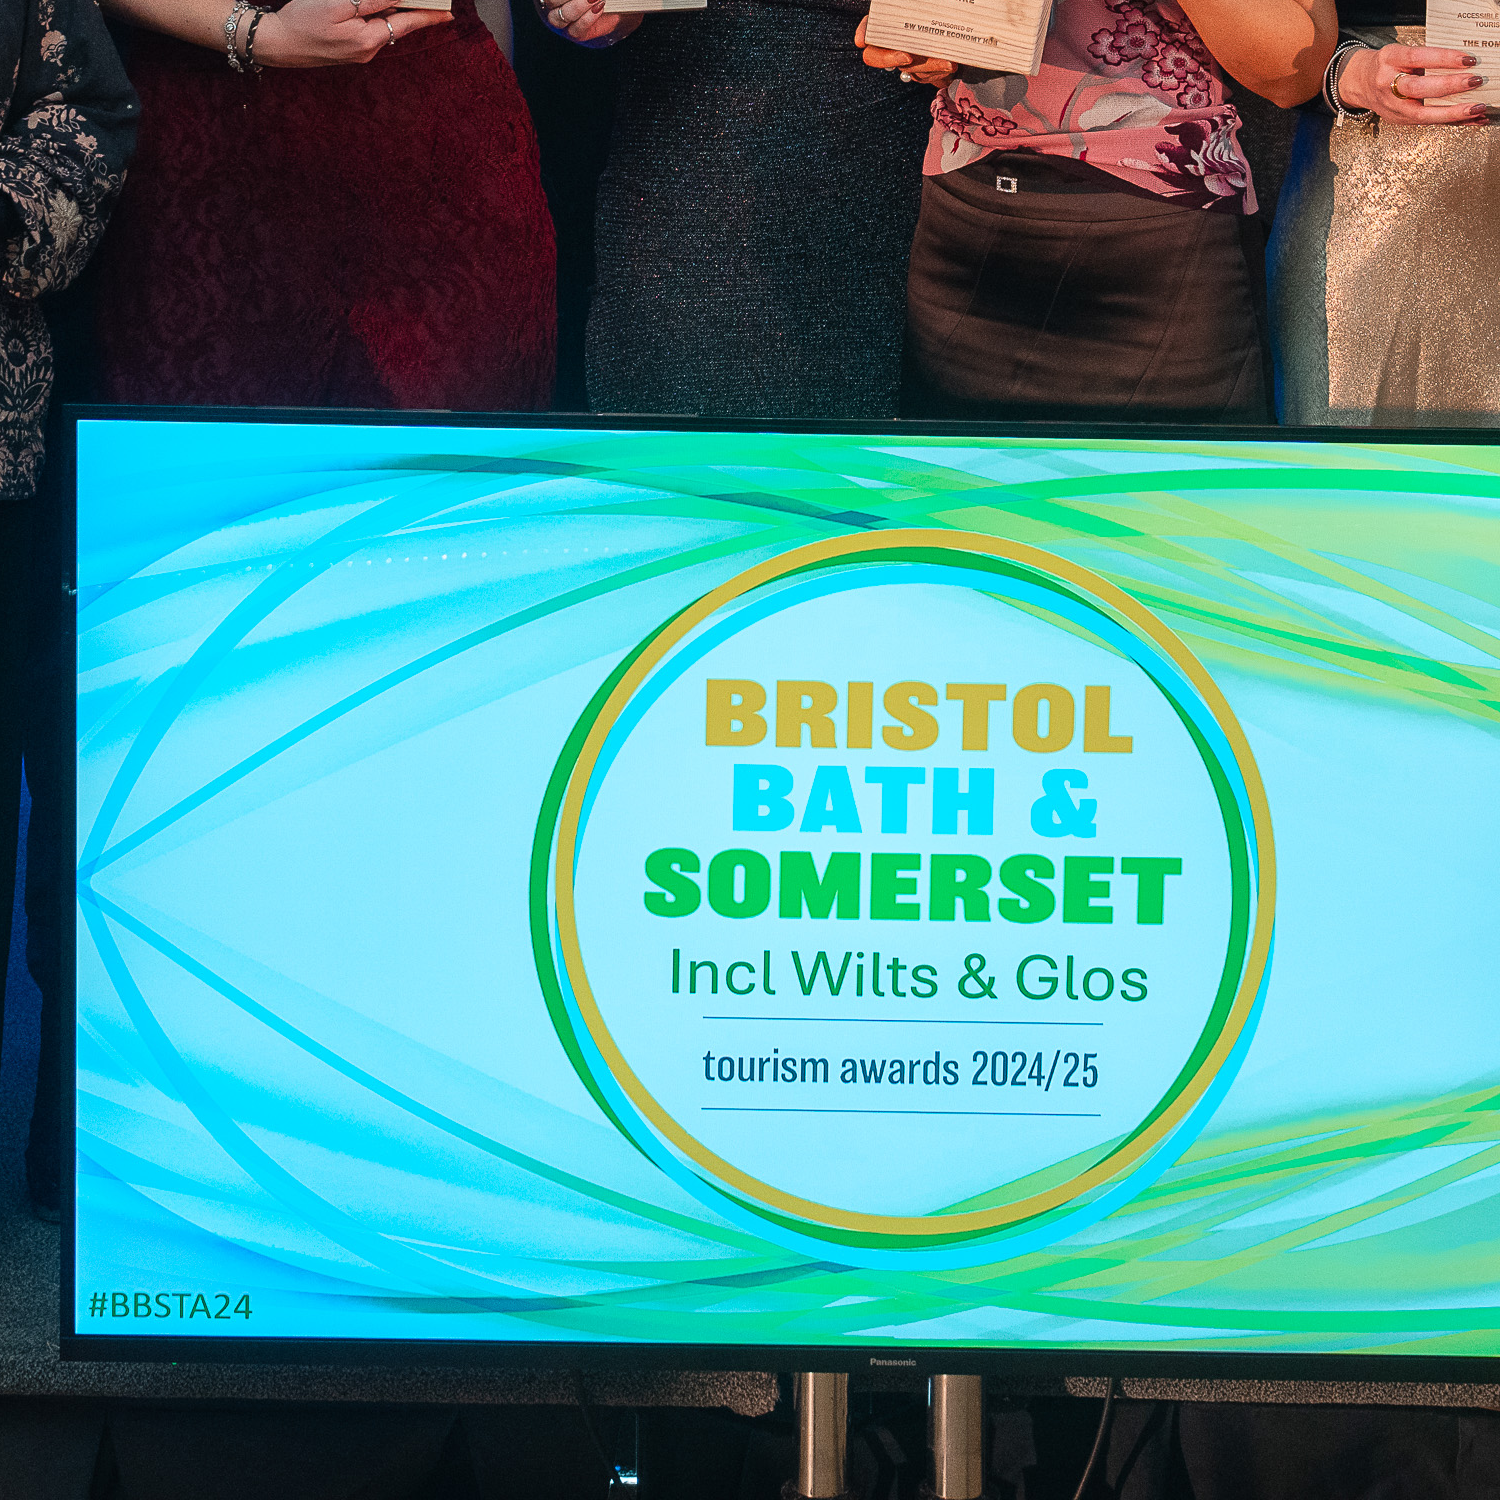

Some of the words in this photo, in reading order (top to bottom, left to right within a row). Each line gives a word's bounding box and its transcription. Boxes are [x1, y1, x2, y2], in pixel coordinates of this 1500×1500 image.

[904, 22, 916, 30] SW
[917, 25, 945, 36] VISITOR
[946, 31, 981, 43] ECONOMY
[931, 20, 965, 31] SPONSORED
[705, 677, 1135, 754] BRISTOL
[731, 763, 995, 836] BATH
[1029, 768, 1099, 839] &
[643, 847, 1183, 925] SOMERSET
[670, 947, 776, 996] Incl
[791, 950, 939, 999] Wilts
[957, 953, 998, 1000] &
[1015, 953, 1149, 1003] Glos
[702, 1048, 830, 1084] tourism
[839, 1051, 960, 1087] awards
[971, 1050, 1100, 1092] 2024/25
[89, 1292, 253, 1319] #BBSTA24
[870, 1358, 916, 1366] Panasonic
